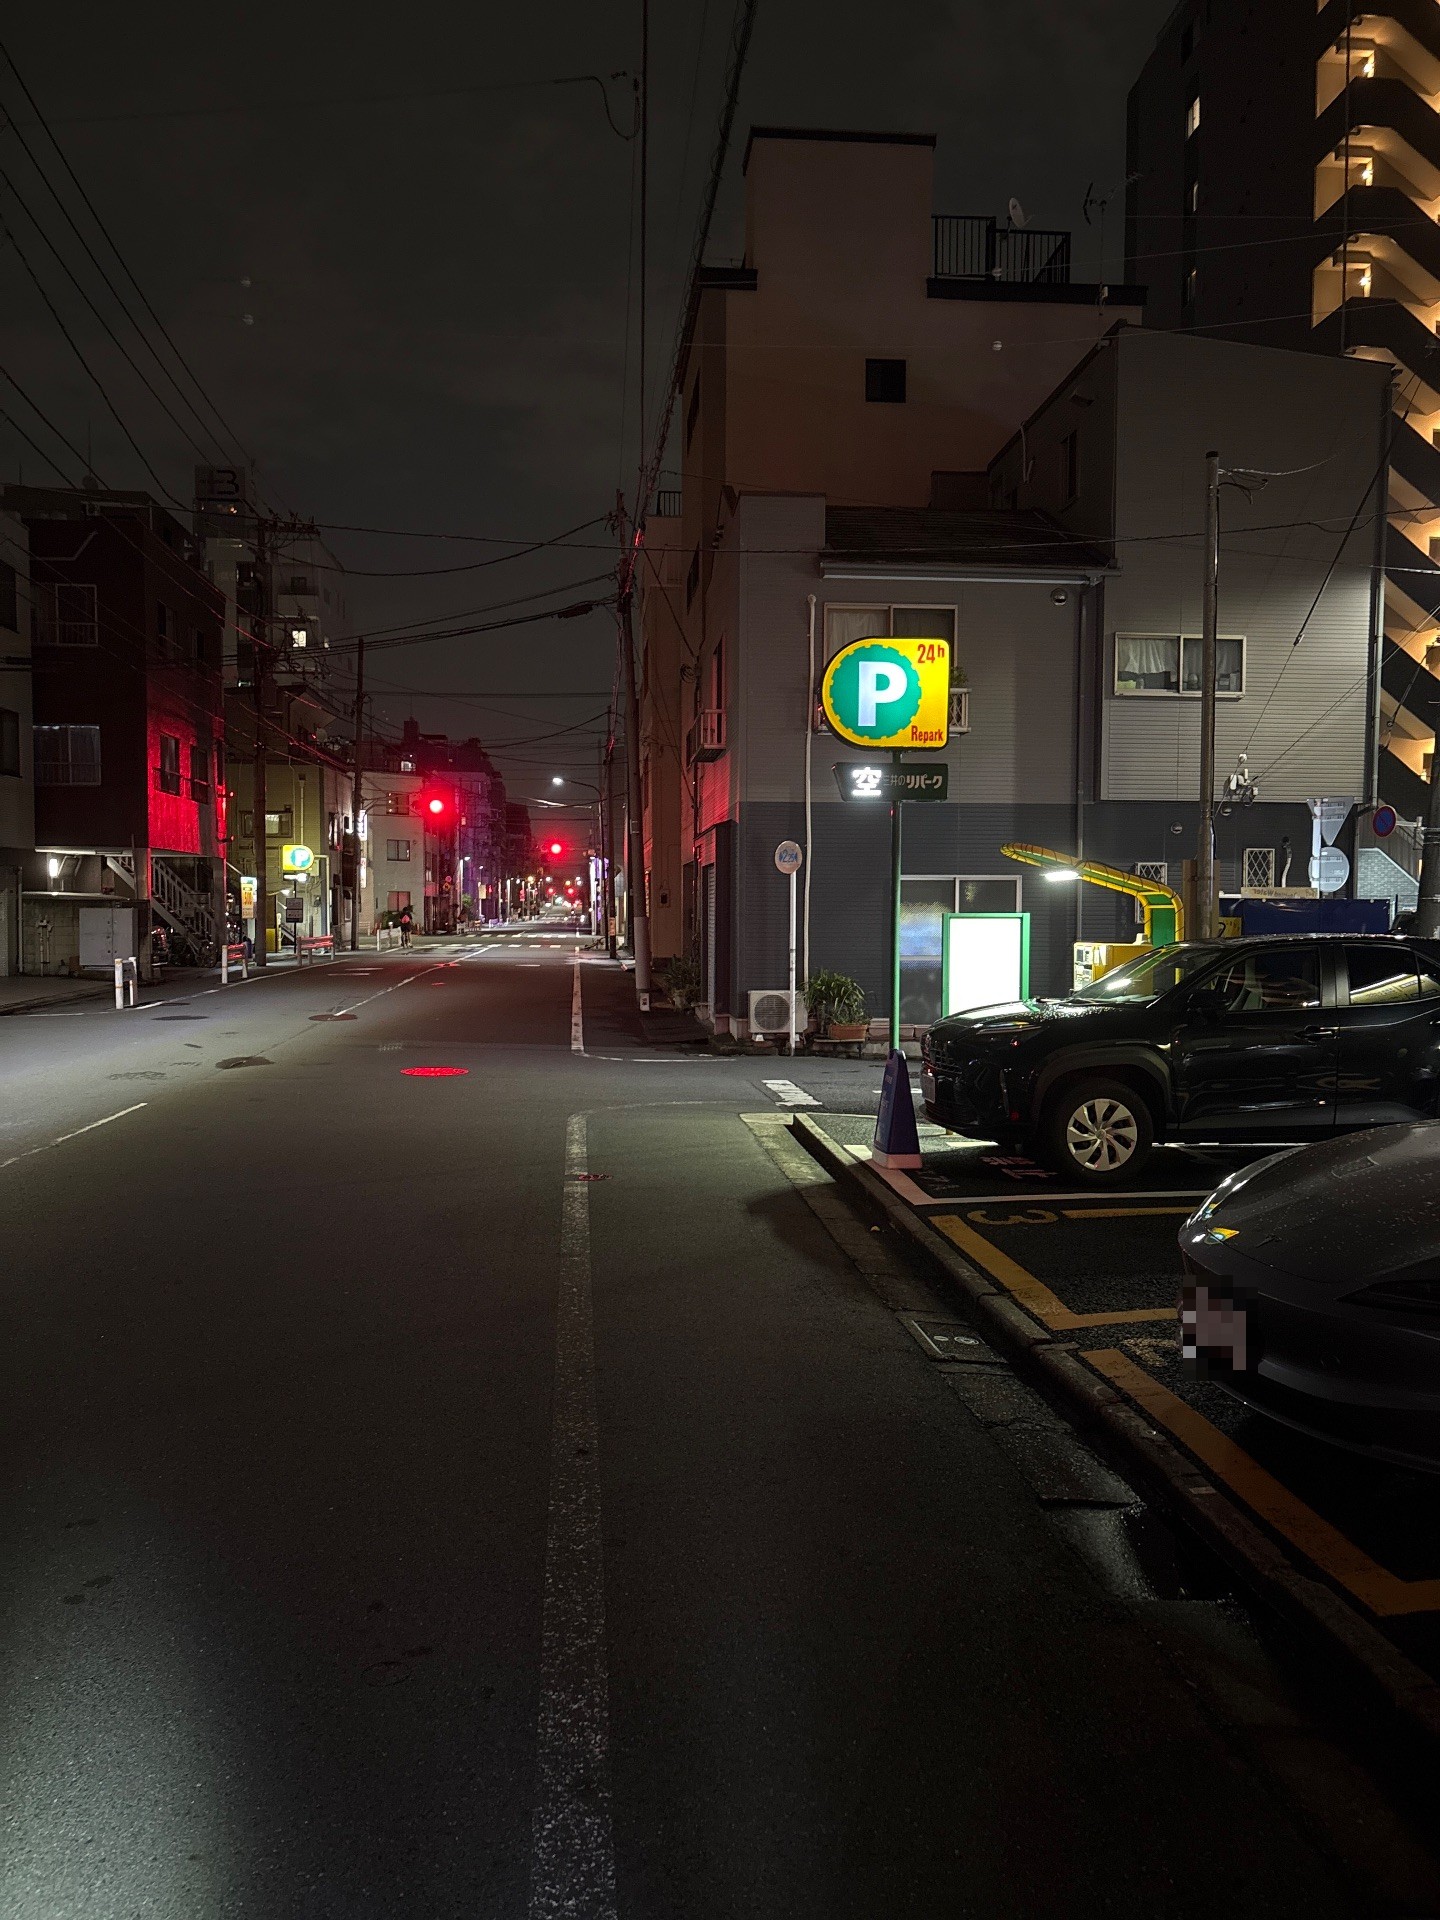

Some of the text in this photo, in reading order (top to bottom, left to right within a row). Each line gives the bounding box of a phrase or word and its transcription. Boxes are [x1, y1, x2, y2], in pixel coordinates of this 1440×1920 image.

[857, 661, 908, 727] P
[910, 725, 944, 744] Repark
[852, 766, 882, 796] 空
[294, 849, 308, 868] P
